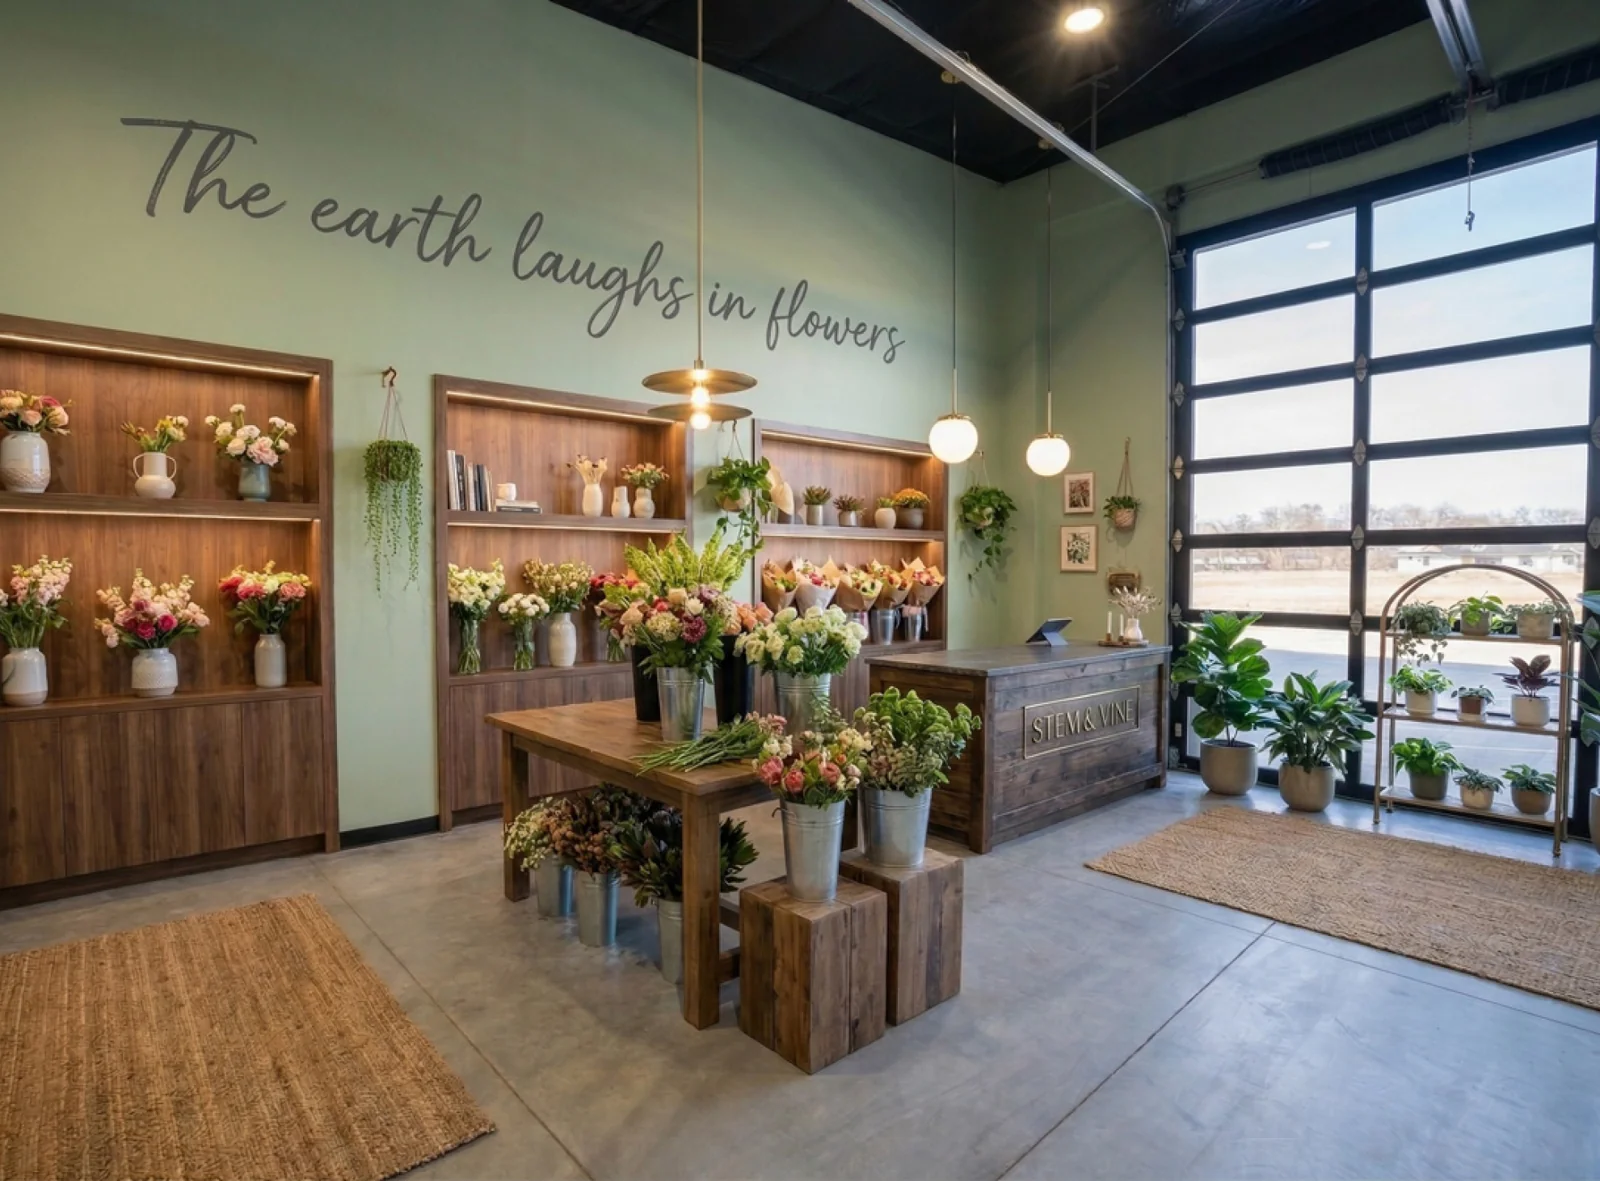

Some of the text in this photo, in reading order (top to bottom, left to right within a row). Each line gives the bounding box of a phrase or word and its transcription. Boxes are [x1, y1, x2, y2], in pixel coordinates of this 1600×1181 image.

[120, 117, 906, 364] The earth laughs in flowers
[1032, 699, 1134, 743] STEM & VINE
